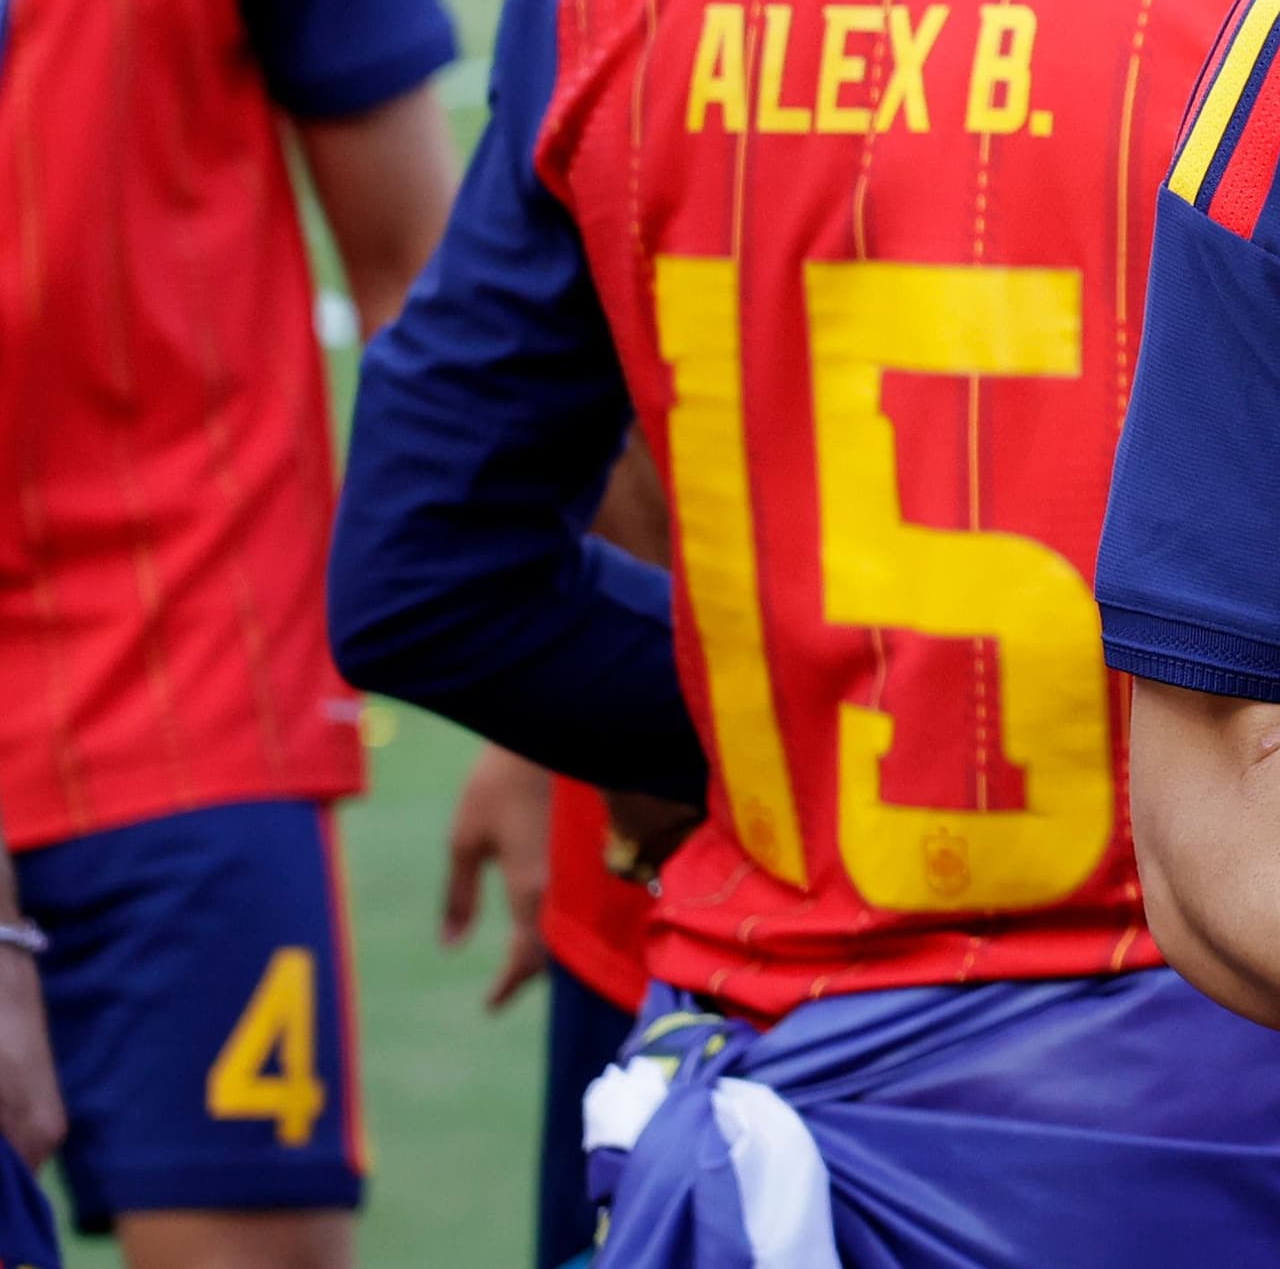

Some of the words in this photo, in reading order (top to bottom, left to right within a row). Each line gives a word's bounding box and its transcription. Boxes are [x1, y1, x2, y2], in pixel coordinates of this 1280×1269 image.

[686, 3, 950, 135] ALEX
[965, 4, 1053, 137] B.
[654, 255, 1113, 913] 15
[206, 945, 325, 1147] 4
